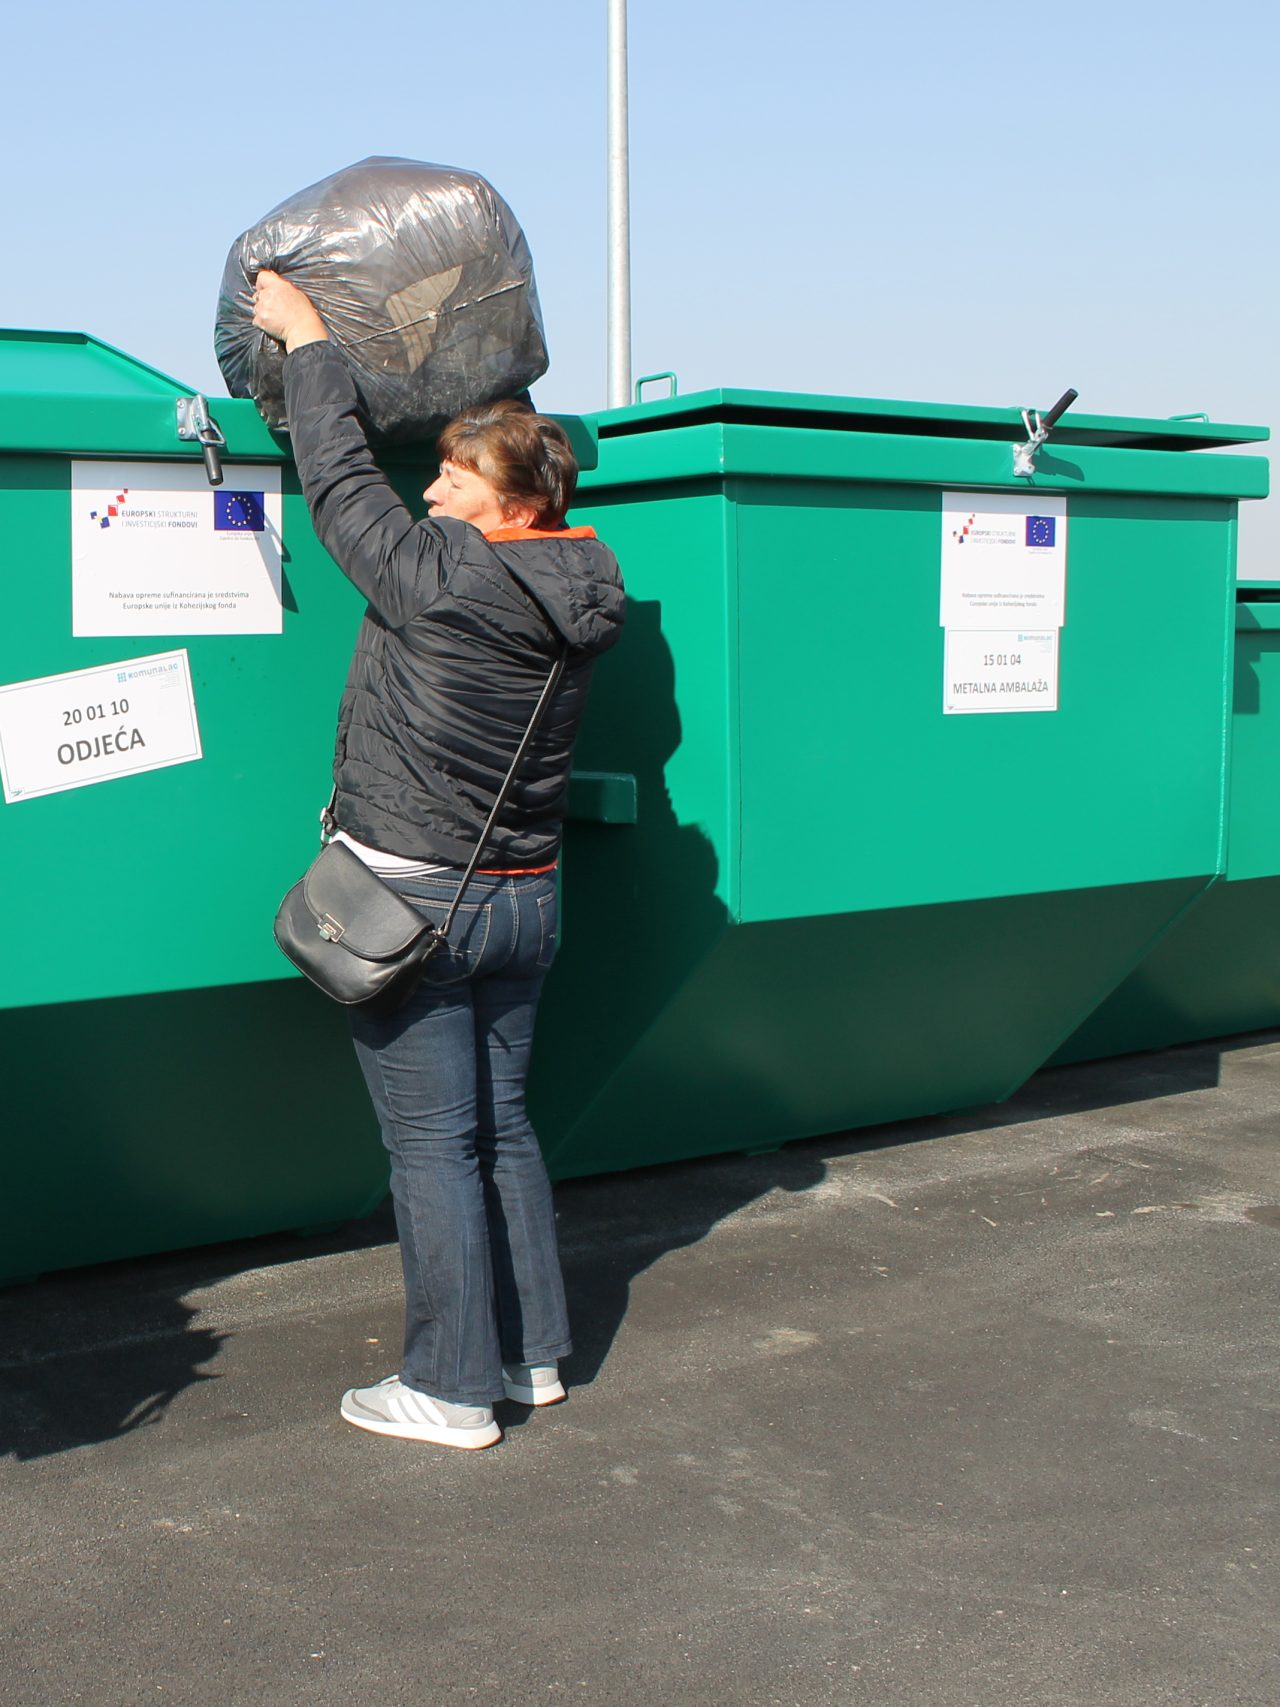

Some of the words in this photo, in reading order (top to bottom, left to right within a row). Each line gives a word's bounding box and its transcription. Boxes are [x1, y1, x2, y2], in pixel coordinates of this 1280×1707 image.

[155, 602, 171, 610] unije
[180, 602, 216, 610] Kohezijskog
[984, 655, 994, 666] 15
[997, 654, 1007, 665] 01
[1010, 654, 1021, 665] 04
[953, 682, 996, 694] METALNA
[999, 679, 1048, 693] AMBALAŽA
[63, 709, 82, 726] 20
[87, 704, 106, 720] 01
[111, 699, 129, 715] 10
[57, 725, 146, 765] ODJEĆA
